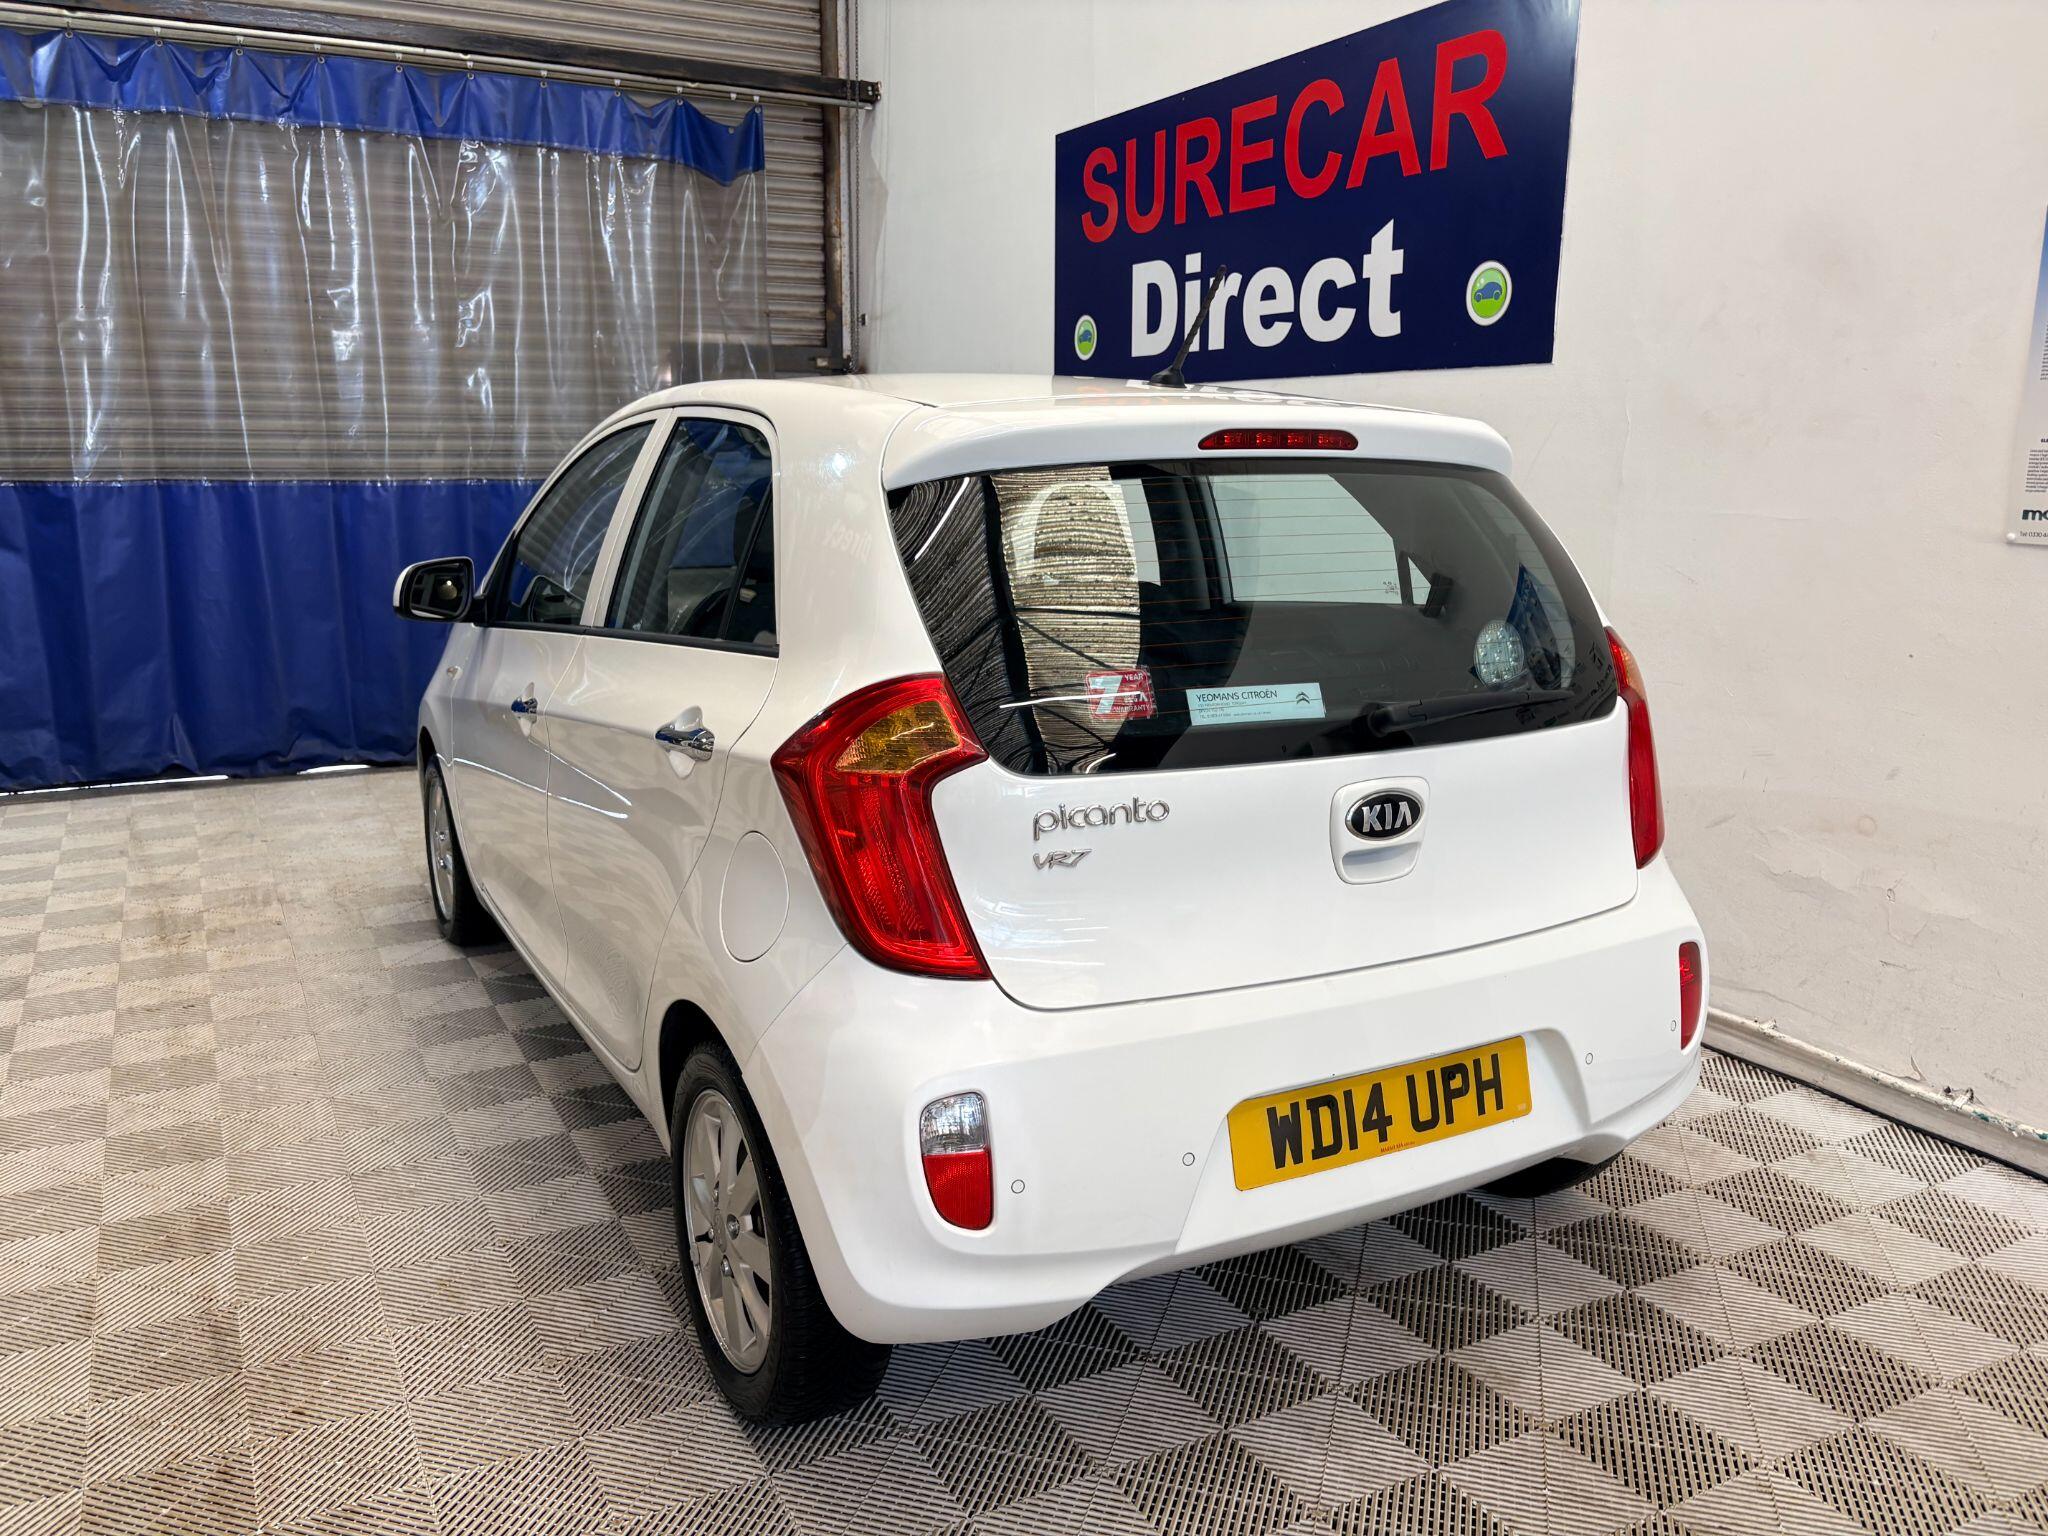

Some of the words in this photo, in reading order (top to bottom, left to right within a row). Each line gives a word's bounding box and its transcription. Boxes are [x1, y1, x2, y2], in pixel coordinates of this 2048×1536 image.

[1081, 29, 1508, 243] SURECAR
[1131, 218, 1404, 357] Direct
[1089, 675, 1123, 714] 7
[1124, 672, 1144, 681] YEAR
[1195, 691, 1240, 703] YEOMANS
[1241, 688, 1278, 700] CITROËN
[1033, 795, 1170, 841] picanto
[1362, 800, 1412, 833] KIA
[1033, 848, 1092, 870] VR7
[1266, 1082, 1393, 1170] WD14
[1406, 1053, 1504, 1133] UPH
